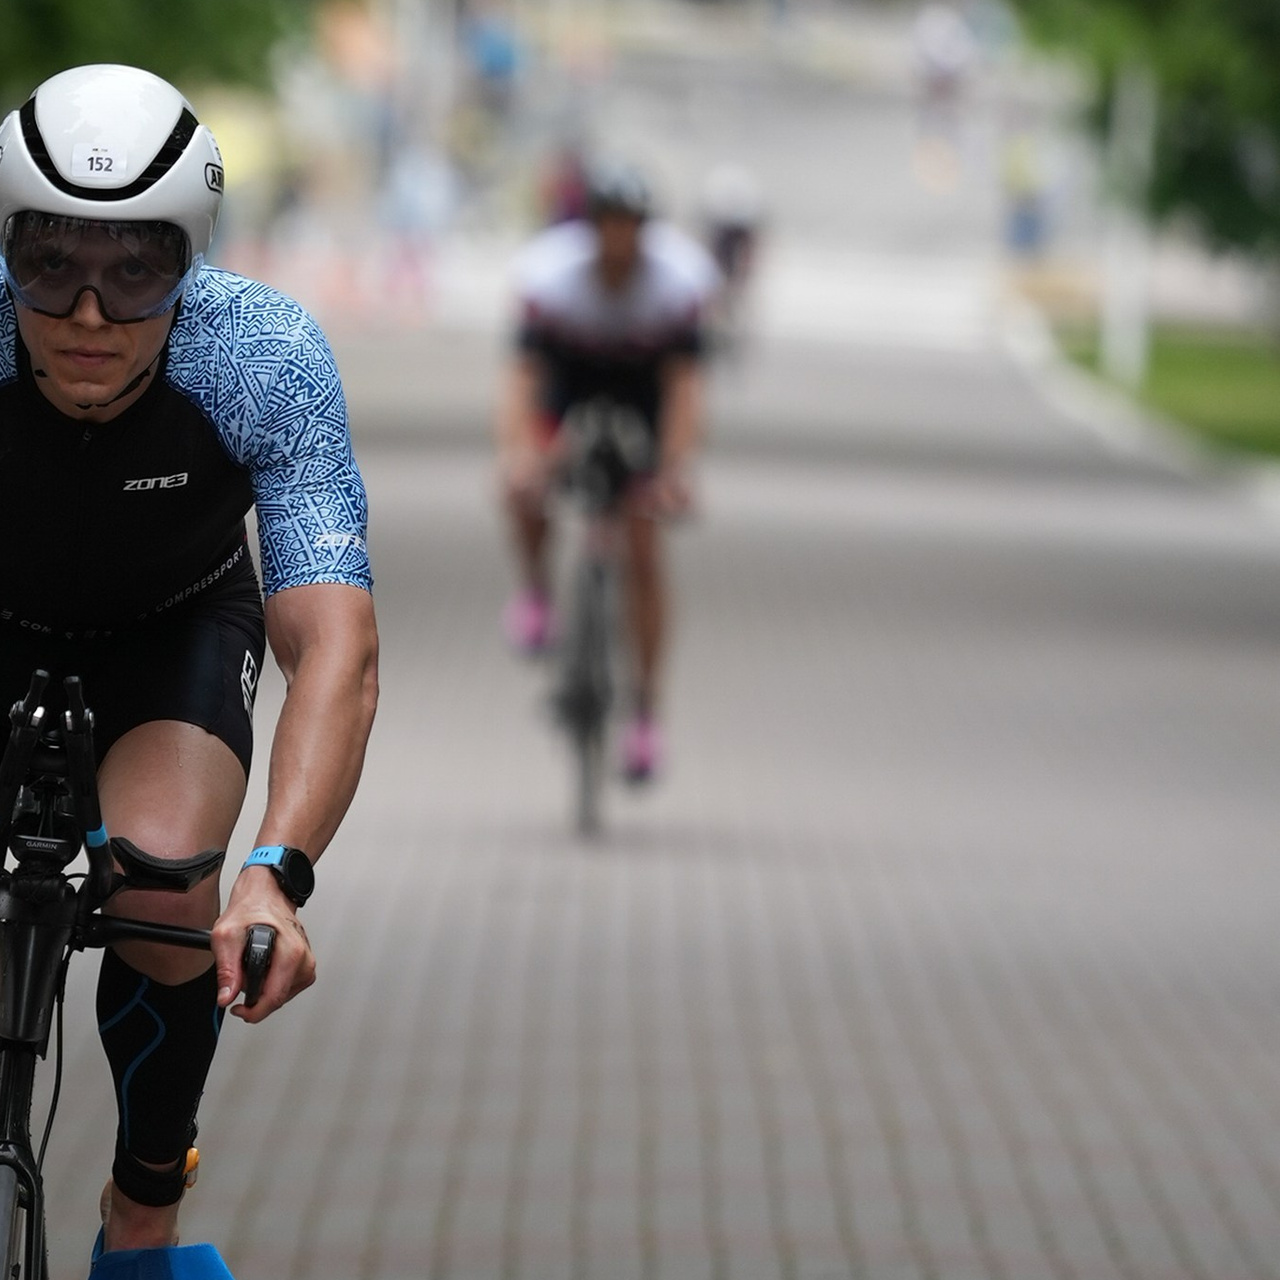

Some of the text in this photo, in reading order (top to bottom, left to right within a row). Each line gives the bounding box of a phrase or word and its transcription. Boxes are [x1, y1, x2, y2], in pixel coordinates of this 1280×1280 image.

[87, 156, 113, 172] 152
[155, 545, 244, 613] COMPRESSPORT
[26, 841, 58, 850] GARMIN
